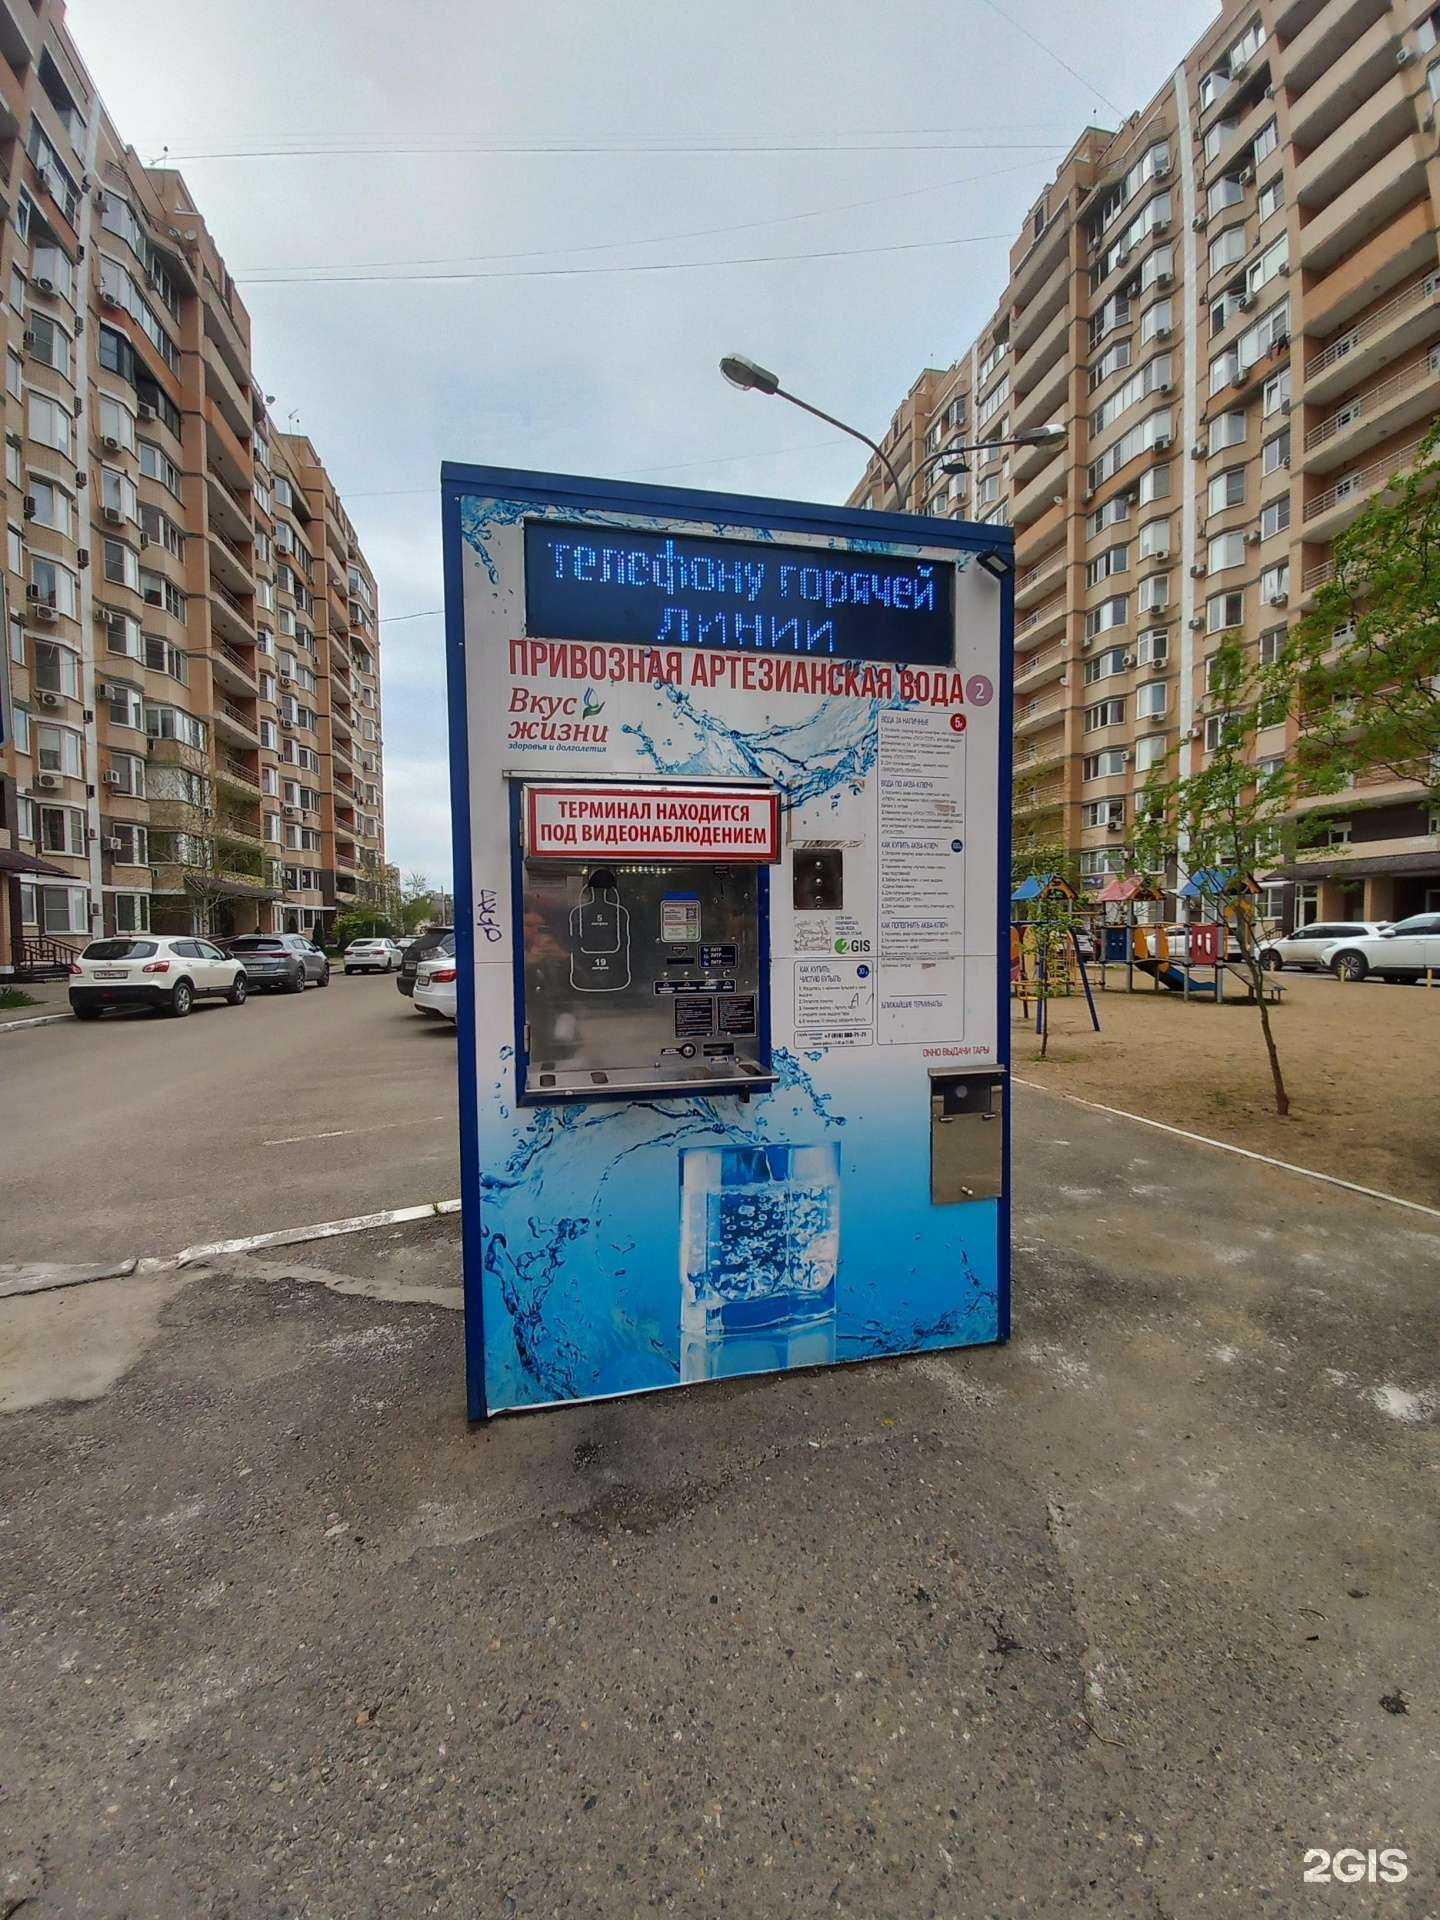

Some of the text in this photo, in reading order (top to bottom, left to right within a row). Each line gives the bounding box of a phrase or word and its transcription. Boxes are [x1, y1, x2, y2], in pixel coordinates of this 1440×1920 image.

[548, 540, 934, 611] телефону горячей
[508, 639, 965, 707] ПРИВОЗНАЯ АРТЕЗИАНСКАЯ ВОДА
[975, 683, 985, 699] 2
[508, 687, 578, 721] Вкус
[508, 721, 608, 742] жизни
[508, 742, 547, 752] здоровья
[556, 743, 607, 753] долголетия
[558, 801, 750, 824] ТЕРМИНАЛ НАХОДИТСЯ
[541, 824, 767, 847] ПОД ВИДЕОНАБЛЮДЕНИЕМ
[597, 914, 603, 922] 5
[835, 938, 871, 955] 2GIS
[594, 958, 607, 966] 19
[922, 1048, 941, 1057] ОКНО
